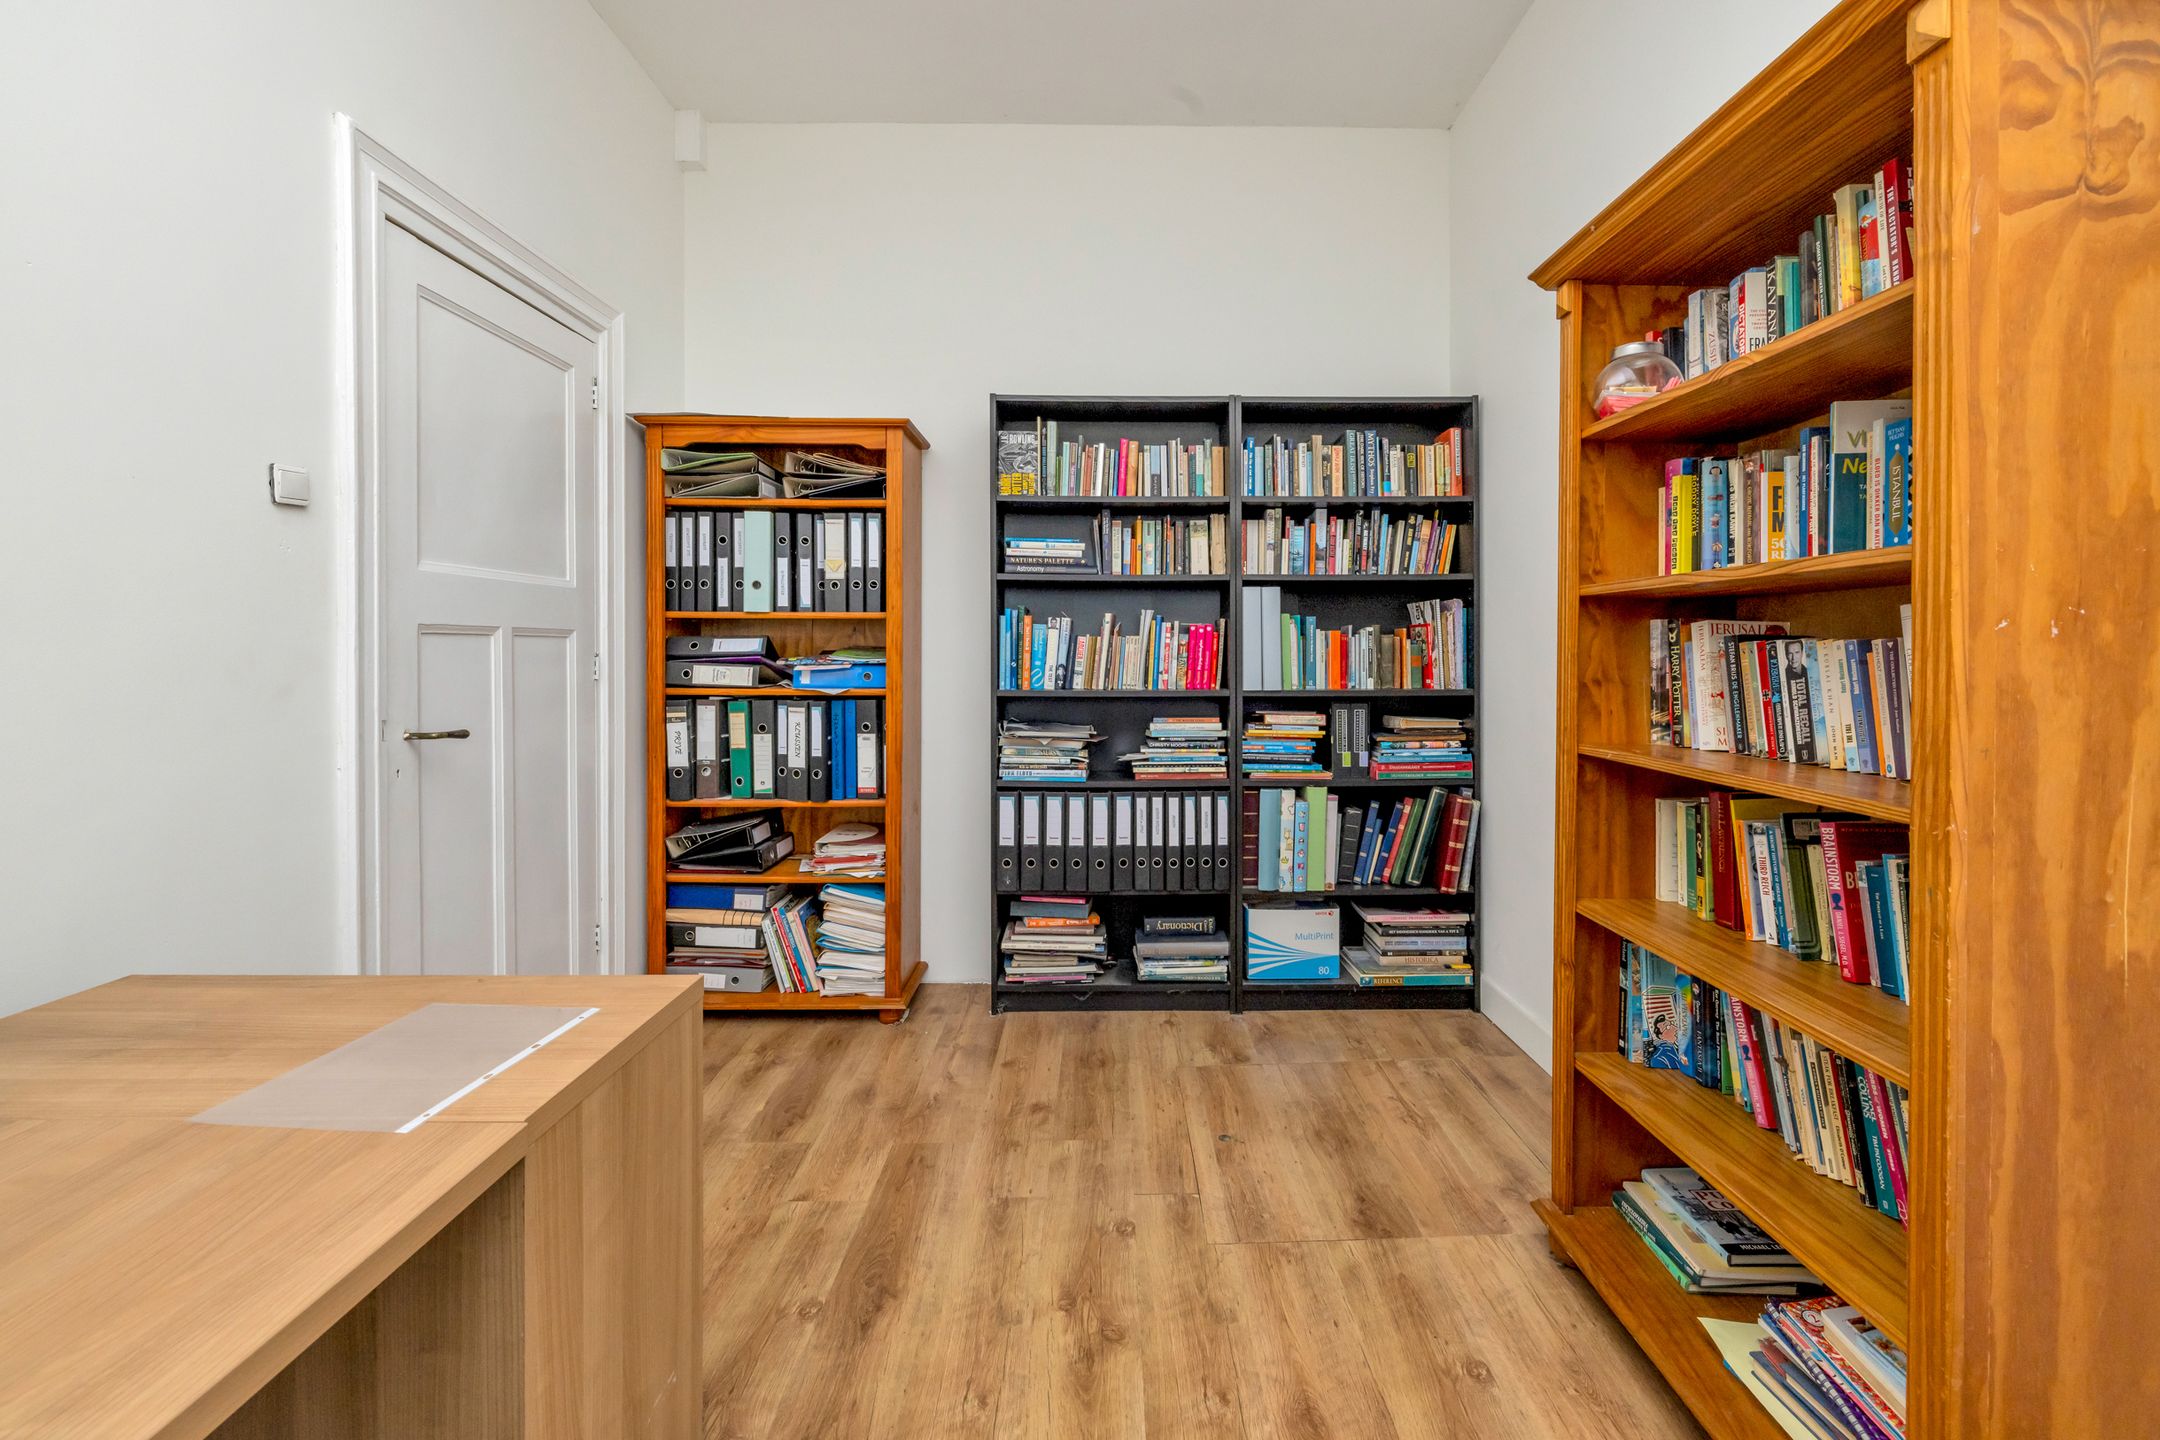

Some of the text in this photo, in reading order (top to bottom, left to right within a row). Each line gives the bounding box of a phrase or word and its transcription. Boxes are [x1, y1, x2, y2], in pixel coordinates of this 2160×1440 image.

[1886, 186, 1895, 202] THE
[1887, 208, 1898, 255] DICTATOR'S
[1892, 465, 1901, 522] ISTANBUL
[1671, 646, 1681, 717] HARRY POTTER
[1732, 681, 1738, 689] DE
[1733, 691, 1742, 739] ENGELENMAKER
[1796, 677, 1810, 744] TOTAL RECALL
[1759, 857, 1770, 896] THIRD REICH
[1822, 828, 1840, 890] BRAINSTORM
[1156, 921, 1203, 931] Dictionary
[1295, 932, 1333, 940] MultiPrint
[1318, 966, 1329, 974] 80
[1822, 1055, 1830, 1073] STEAK
[1829, 1088, 1838, 1121] BREAKFAST
[1858, 1076, 1870, 1118] COLLINS
[1877, 1106, 1888, 1139] WOMEN
[1875, 1159, 1886, 1190] COOGAN
